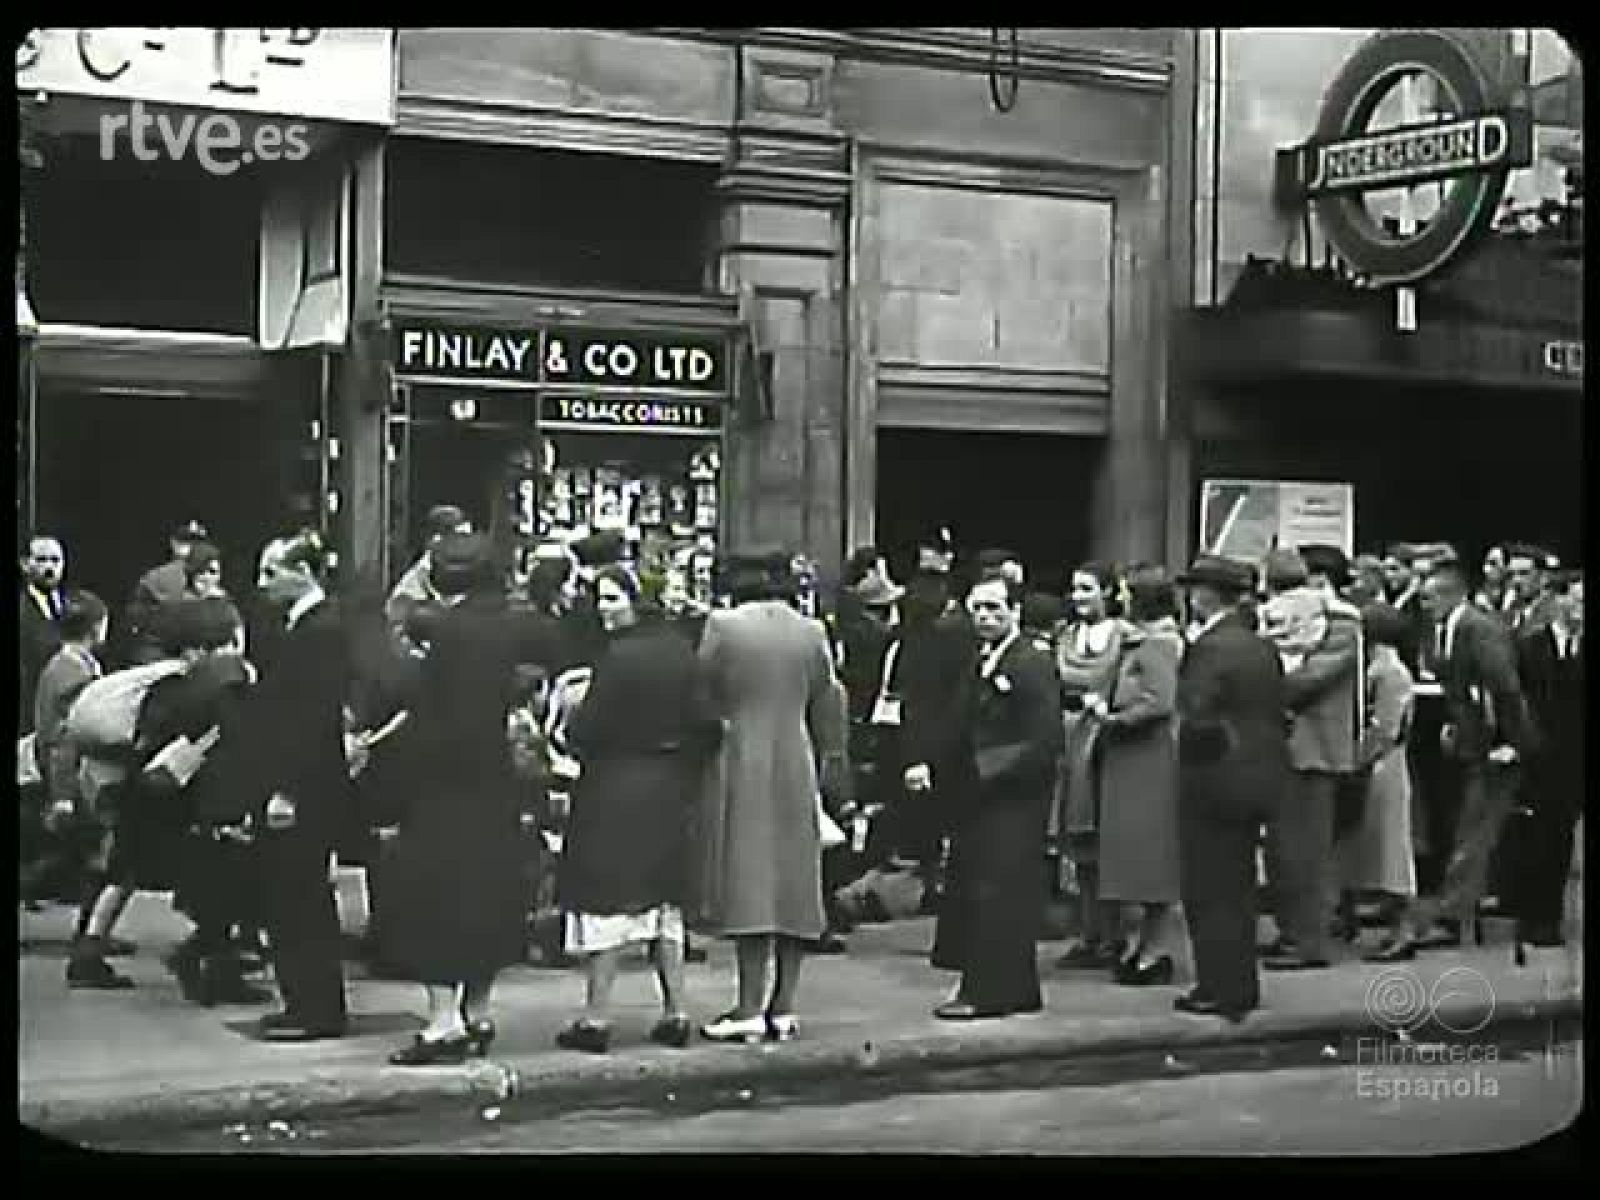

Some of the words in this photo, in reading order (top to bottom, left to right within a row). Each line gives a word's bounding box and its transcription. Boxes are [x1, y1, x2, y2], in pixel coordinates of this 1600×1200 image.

[1299, 116, 1508, 191] UNDERGROUND
[403, 331, 531, 372] FINLAY
[546, 340, 568, 373] &
[583, 343, 639, 377] CO
[653, 346, 715, 382] LTD
